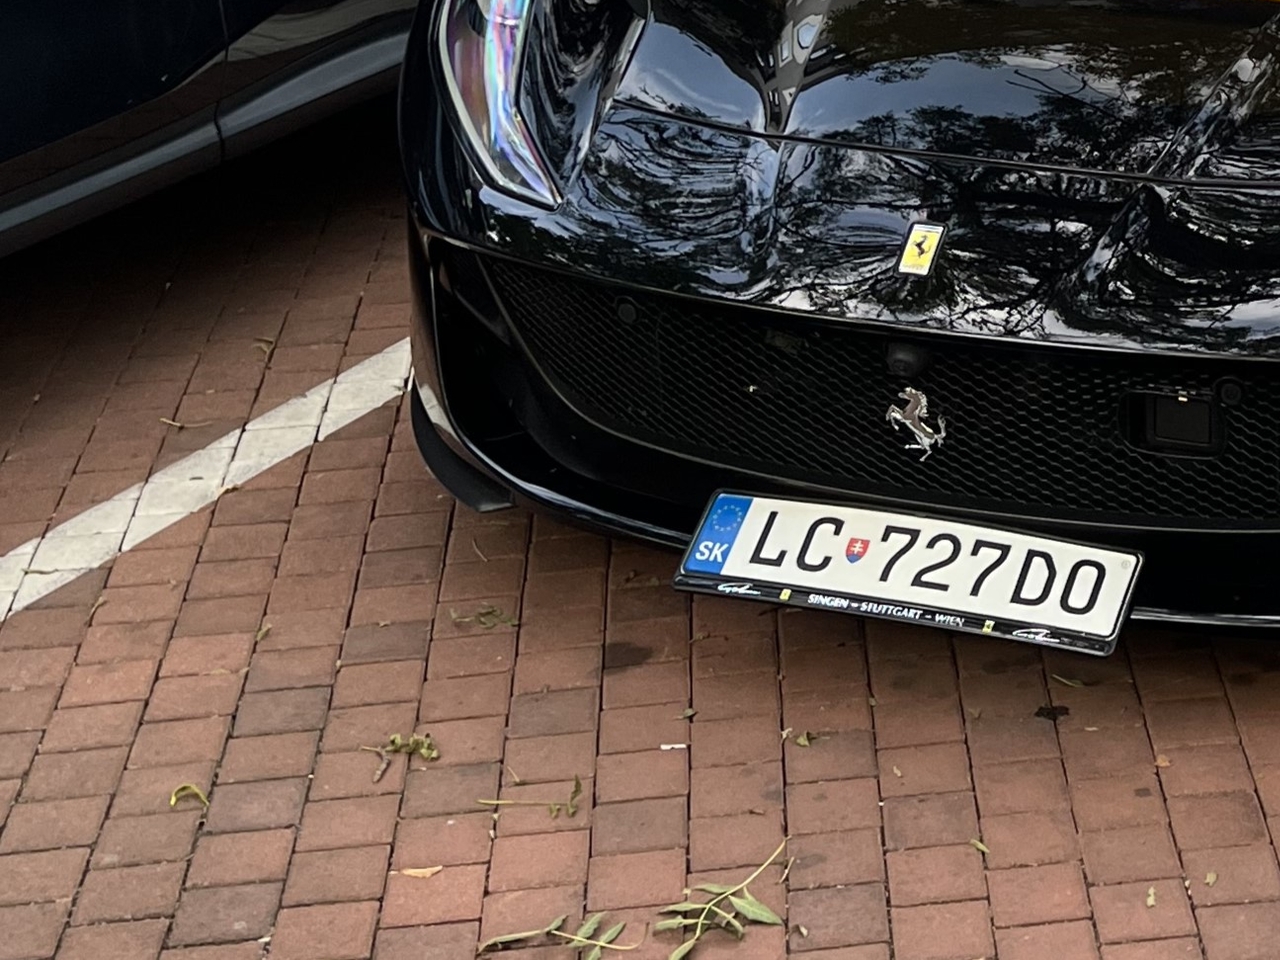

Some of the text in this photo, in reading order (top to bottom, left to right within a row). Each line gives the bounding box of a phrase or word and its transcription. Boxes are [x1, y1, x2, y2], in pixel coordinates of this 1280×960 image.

[695, 541, 729, 563] SK
[749, 511, 1107, 615] LC 727DO
[807, 593, 849, 609] SINGEN
[860, 602, 923, 620] STUTTGART
[935, 613, 965, 628] WIEN
